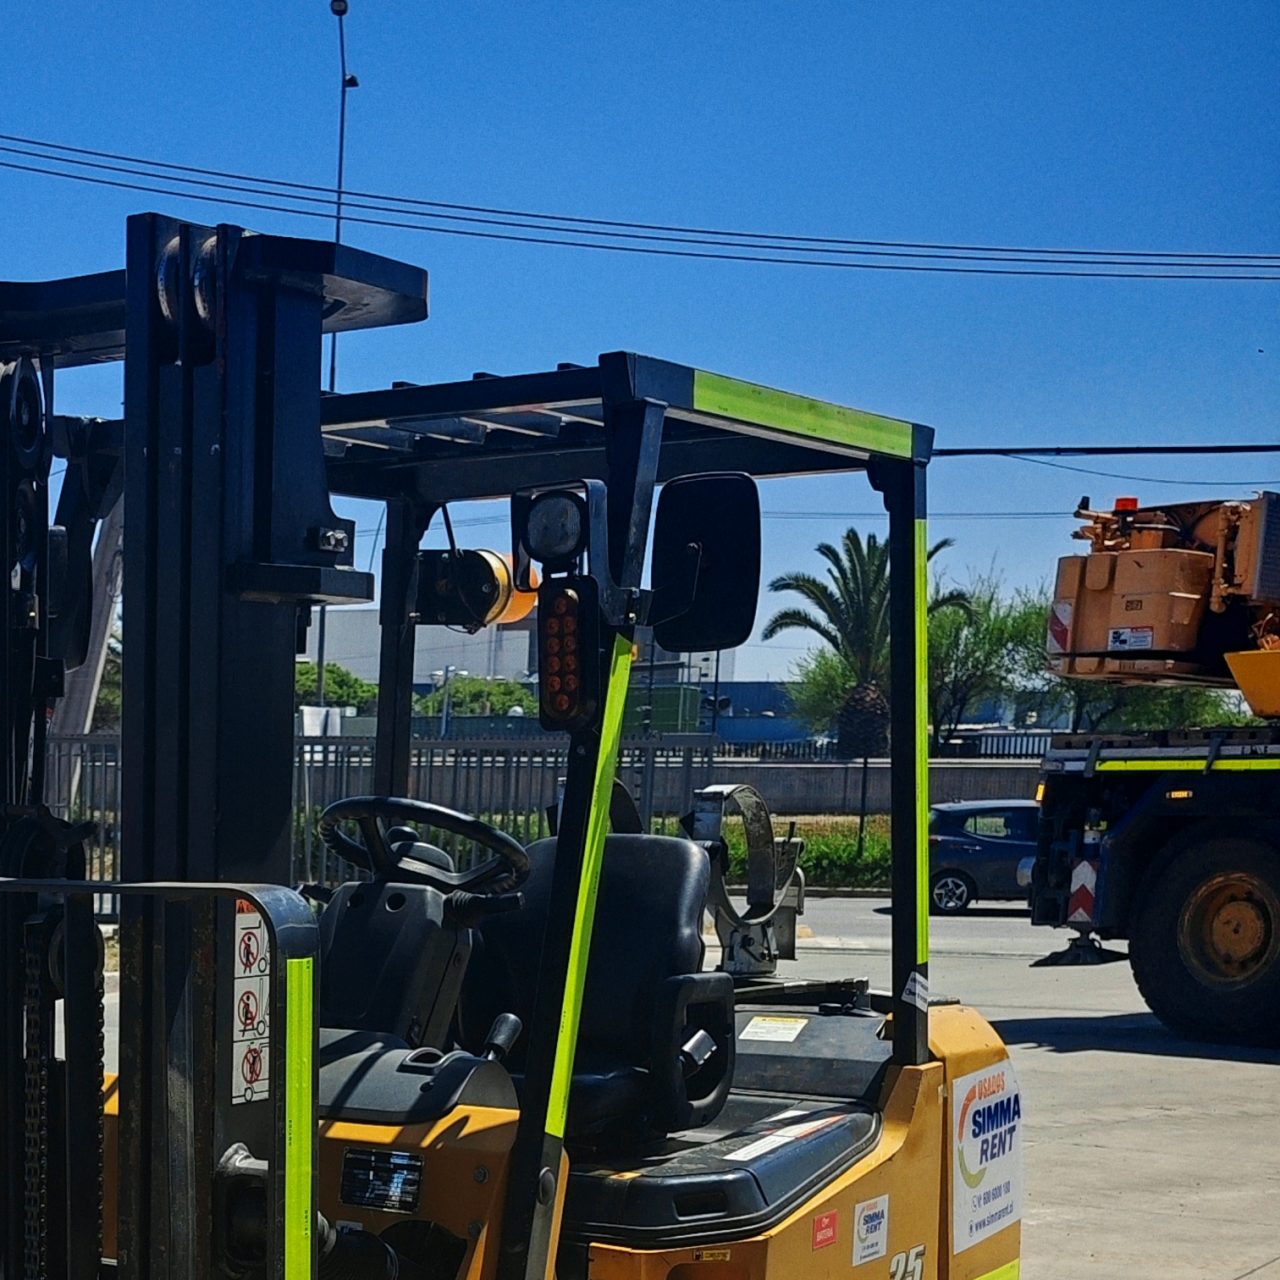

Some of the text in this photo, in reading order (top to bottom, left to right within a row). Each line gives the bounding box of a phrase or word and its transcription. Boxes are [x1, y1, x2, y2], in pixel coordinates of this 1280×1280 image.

[971, 1093, 1021, 1139] SIMMA
[979, 1124, 1016, 1166] RENT
[863, 1208, 885, 1226] SIMMA
